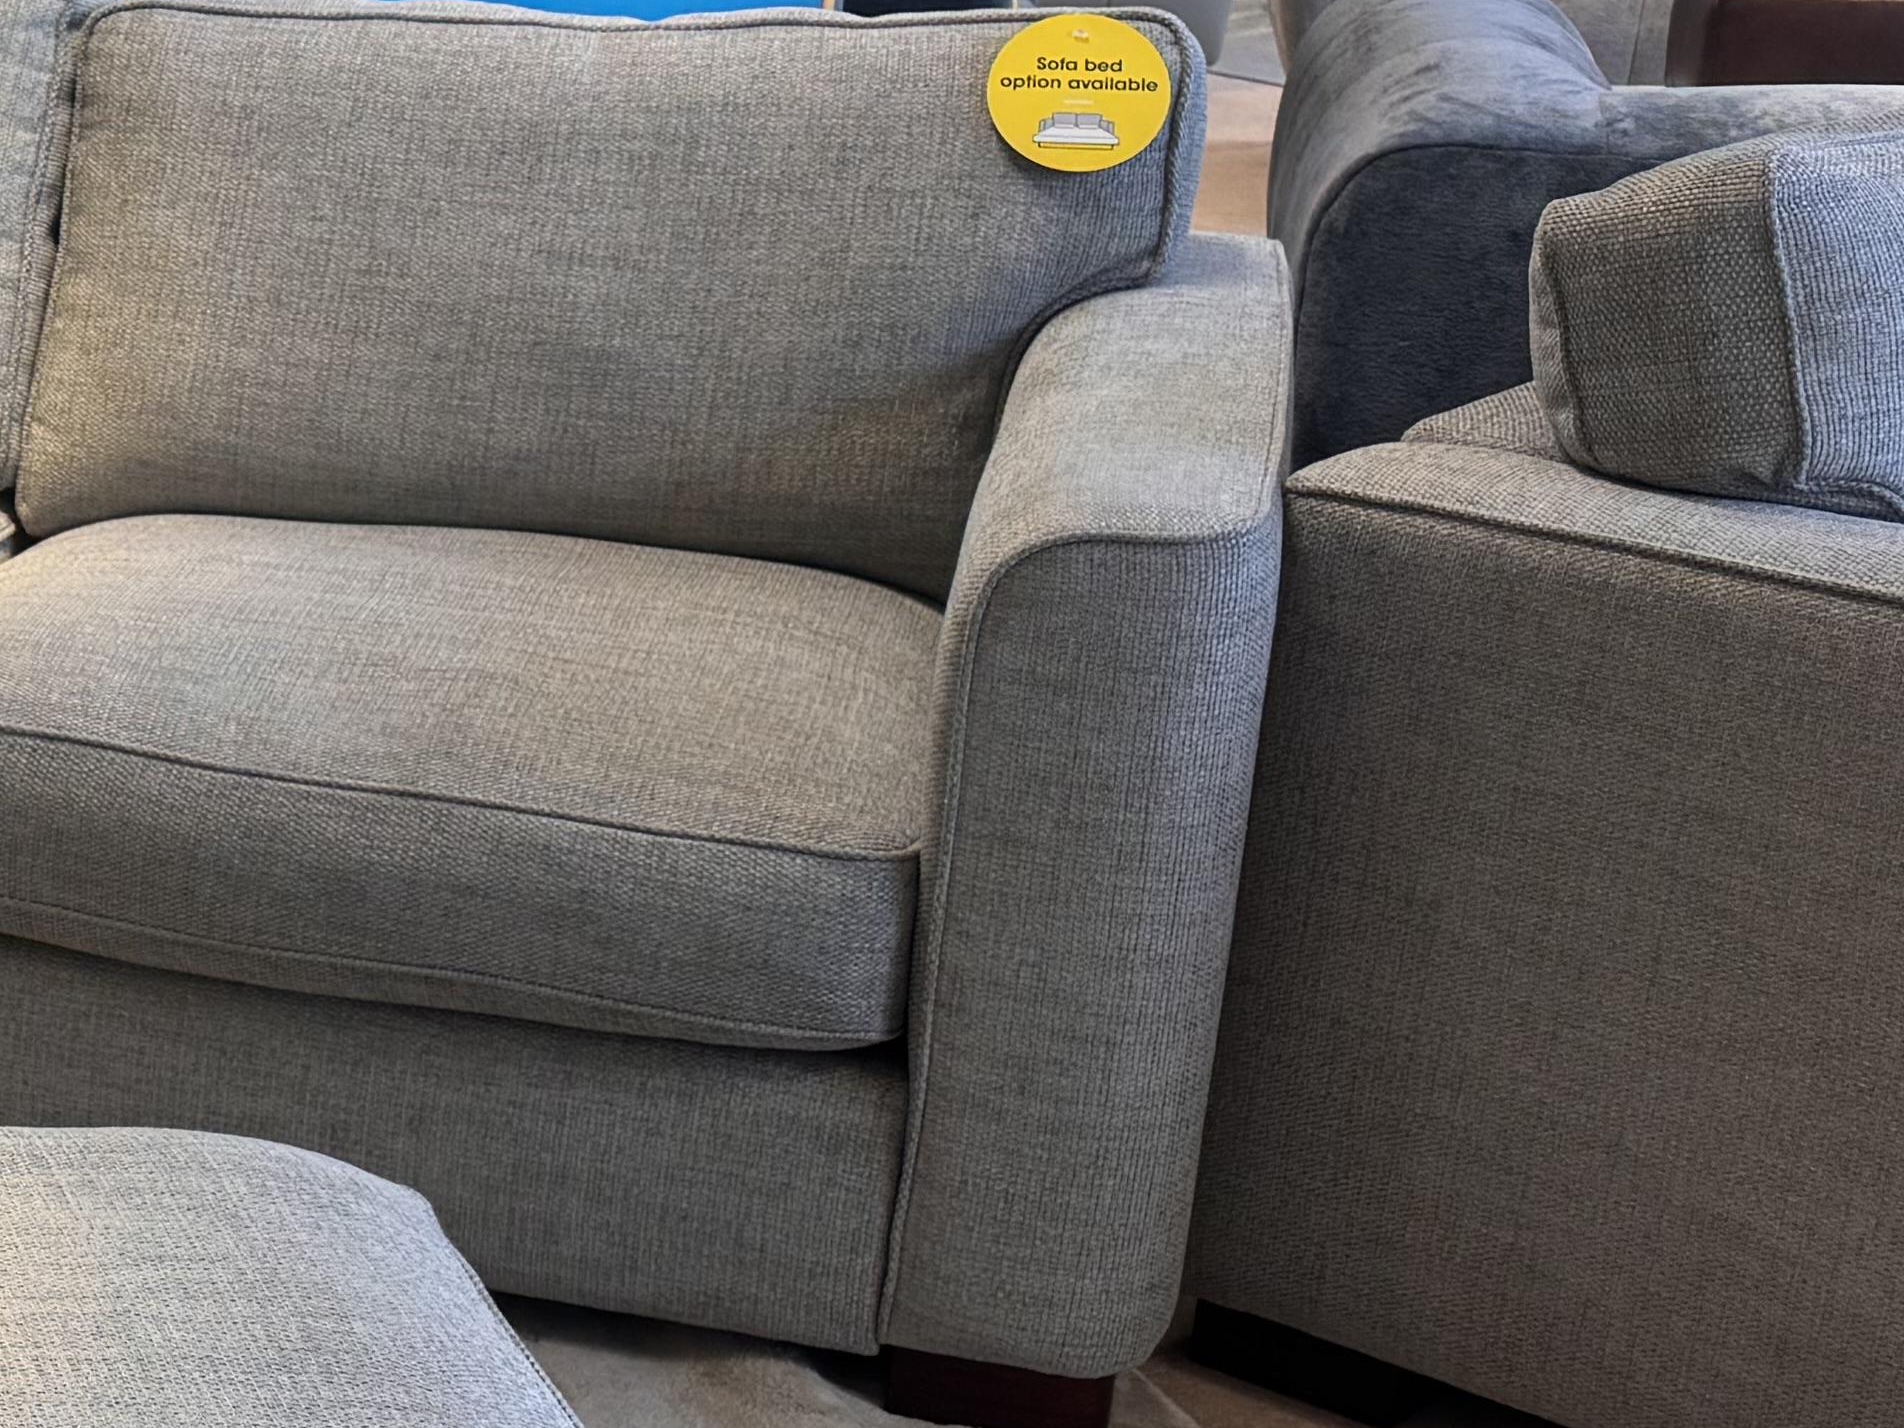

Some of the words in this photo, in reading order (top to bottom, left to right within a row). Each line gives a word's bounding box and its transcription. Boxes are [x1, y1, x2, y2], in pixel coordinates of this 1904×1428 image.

[1036, 56, 1078, 71] Sofa
[1085, 58, 1123, 72] bed
[1000, 75, 1062, 91] option
[1068, 76, 1159, 92] available
